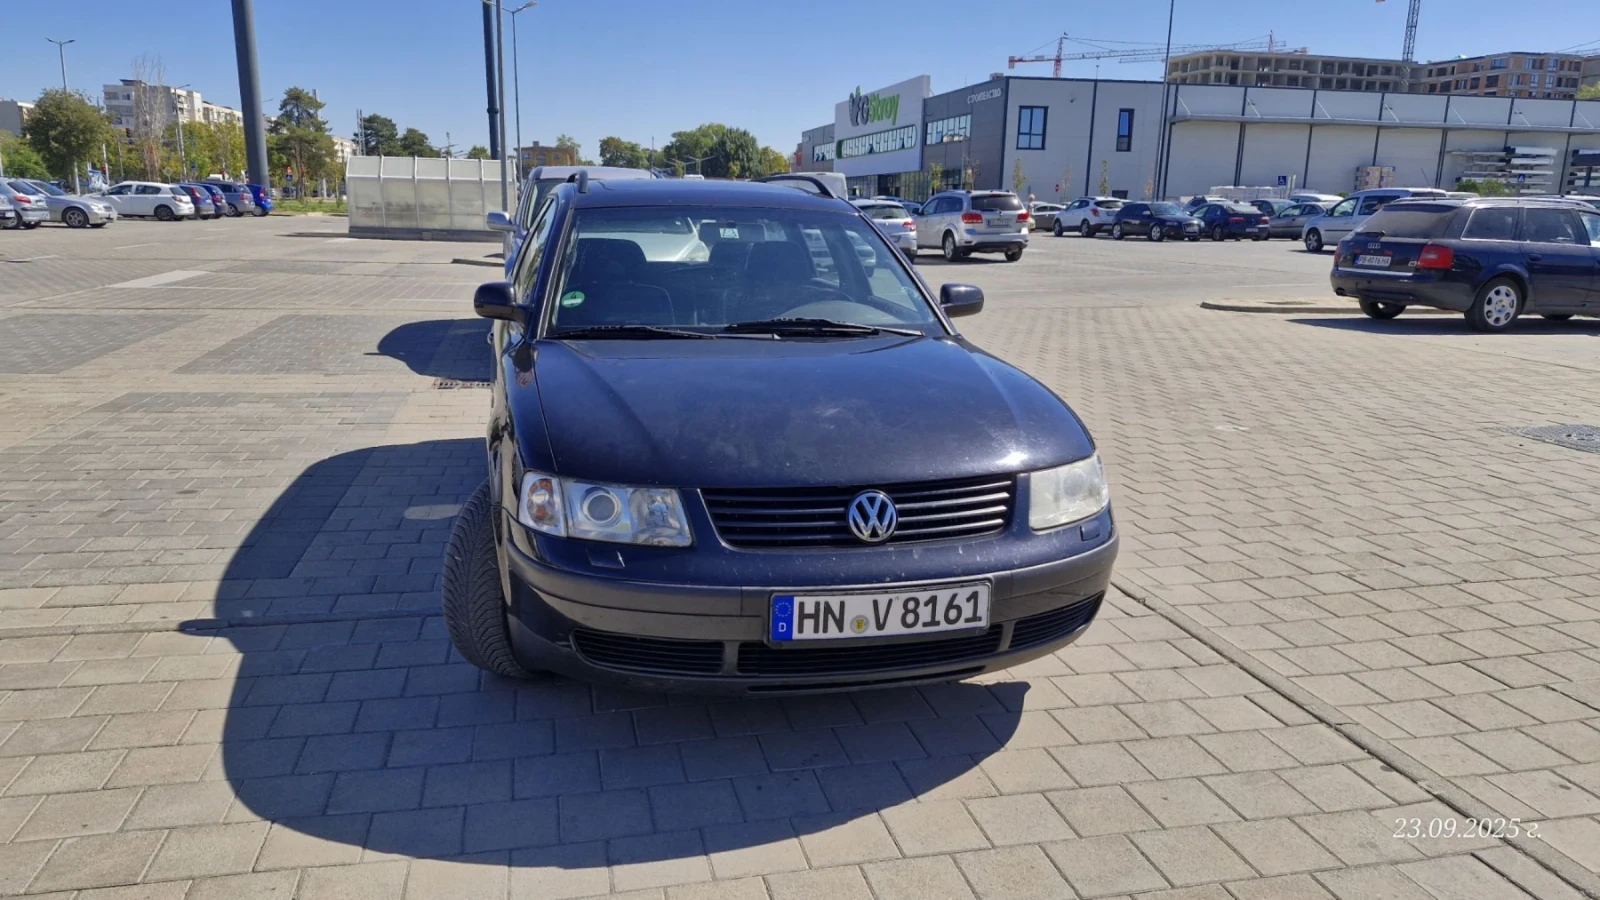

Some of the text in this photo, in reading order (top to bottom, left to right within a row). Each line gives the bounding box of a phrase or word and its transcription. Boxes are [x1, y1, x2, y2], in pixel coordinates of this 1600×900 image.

[797, 590, 982, 634] HN V 8161
[778, 622, 786, 633] D
